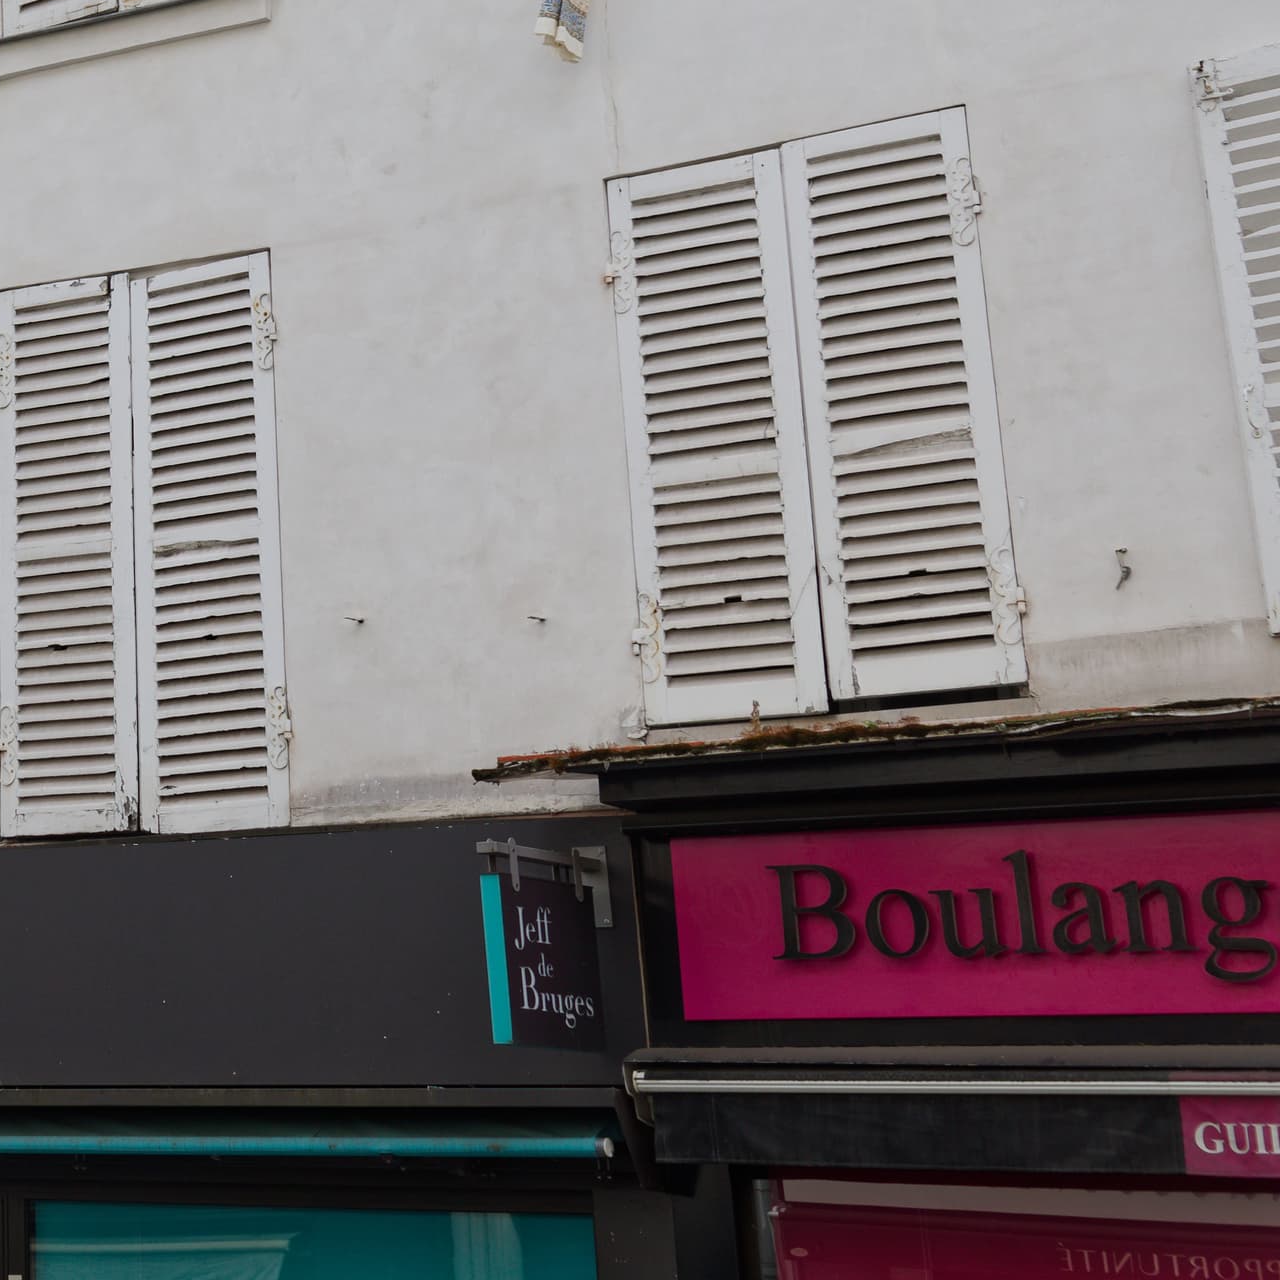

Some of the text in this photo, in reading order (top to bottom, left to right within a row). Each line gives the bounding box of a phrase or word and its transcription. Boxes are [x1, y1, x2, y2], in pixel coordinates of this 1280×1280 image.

[514, 905, 553, 950] Jeff
[764, 848, 1279, 983] Boulang
[537, 952, 554, 978] de
[520, 966, 594, 1029] Bruges
